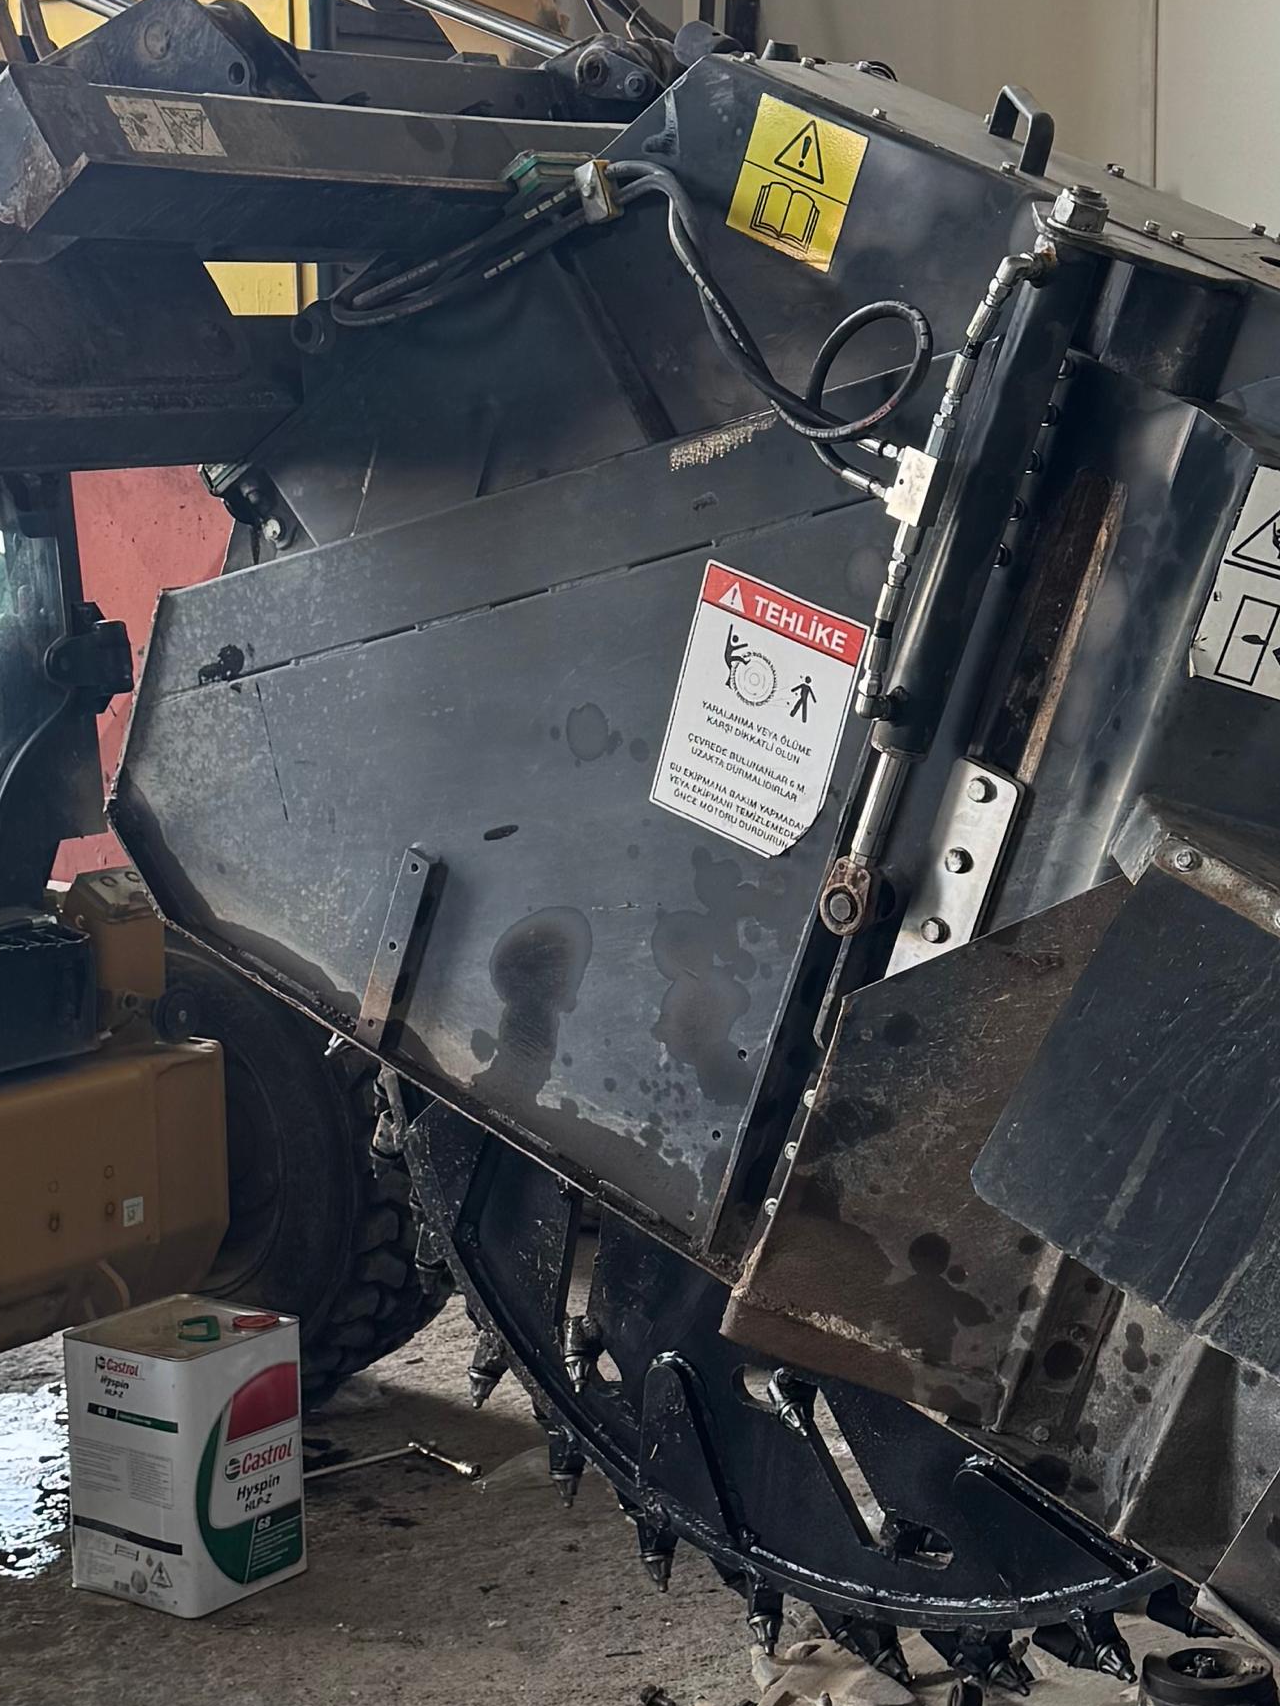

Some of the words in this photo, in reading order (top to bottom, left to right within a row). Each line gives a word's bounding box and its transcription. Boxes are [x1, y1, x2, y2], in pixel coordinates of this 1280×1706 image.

[754, 594, 848, 654] TEHLİKE
[702, 700, 754, 731] YARALANMA
[757, 724, 779, 742] VEYA
[780, 734, 813, 757] ÖLÜME
[706, 715, 733, 734] KARŞI
[734, 727, 775, 752] DİKKATLİ
[775, 747, 801, 765] OLUN
[687, 732, 728, 757] ÇEVREDE
[730, 751, 788, 785] BULUNANLAR
[691, 746, 725, 768] UZAKTA
[699, 800, 738, 824] MOTORU
[106, 1358, 139, 1377] Castrol
[242, 1436, 293, 1475] Castrol
[236, 1474, 281, 1501] Hyspin
[244, 1493, 273, 1513] HLP-Z
[257, 1516, 271, 1530] 68
